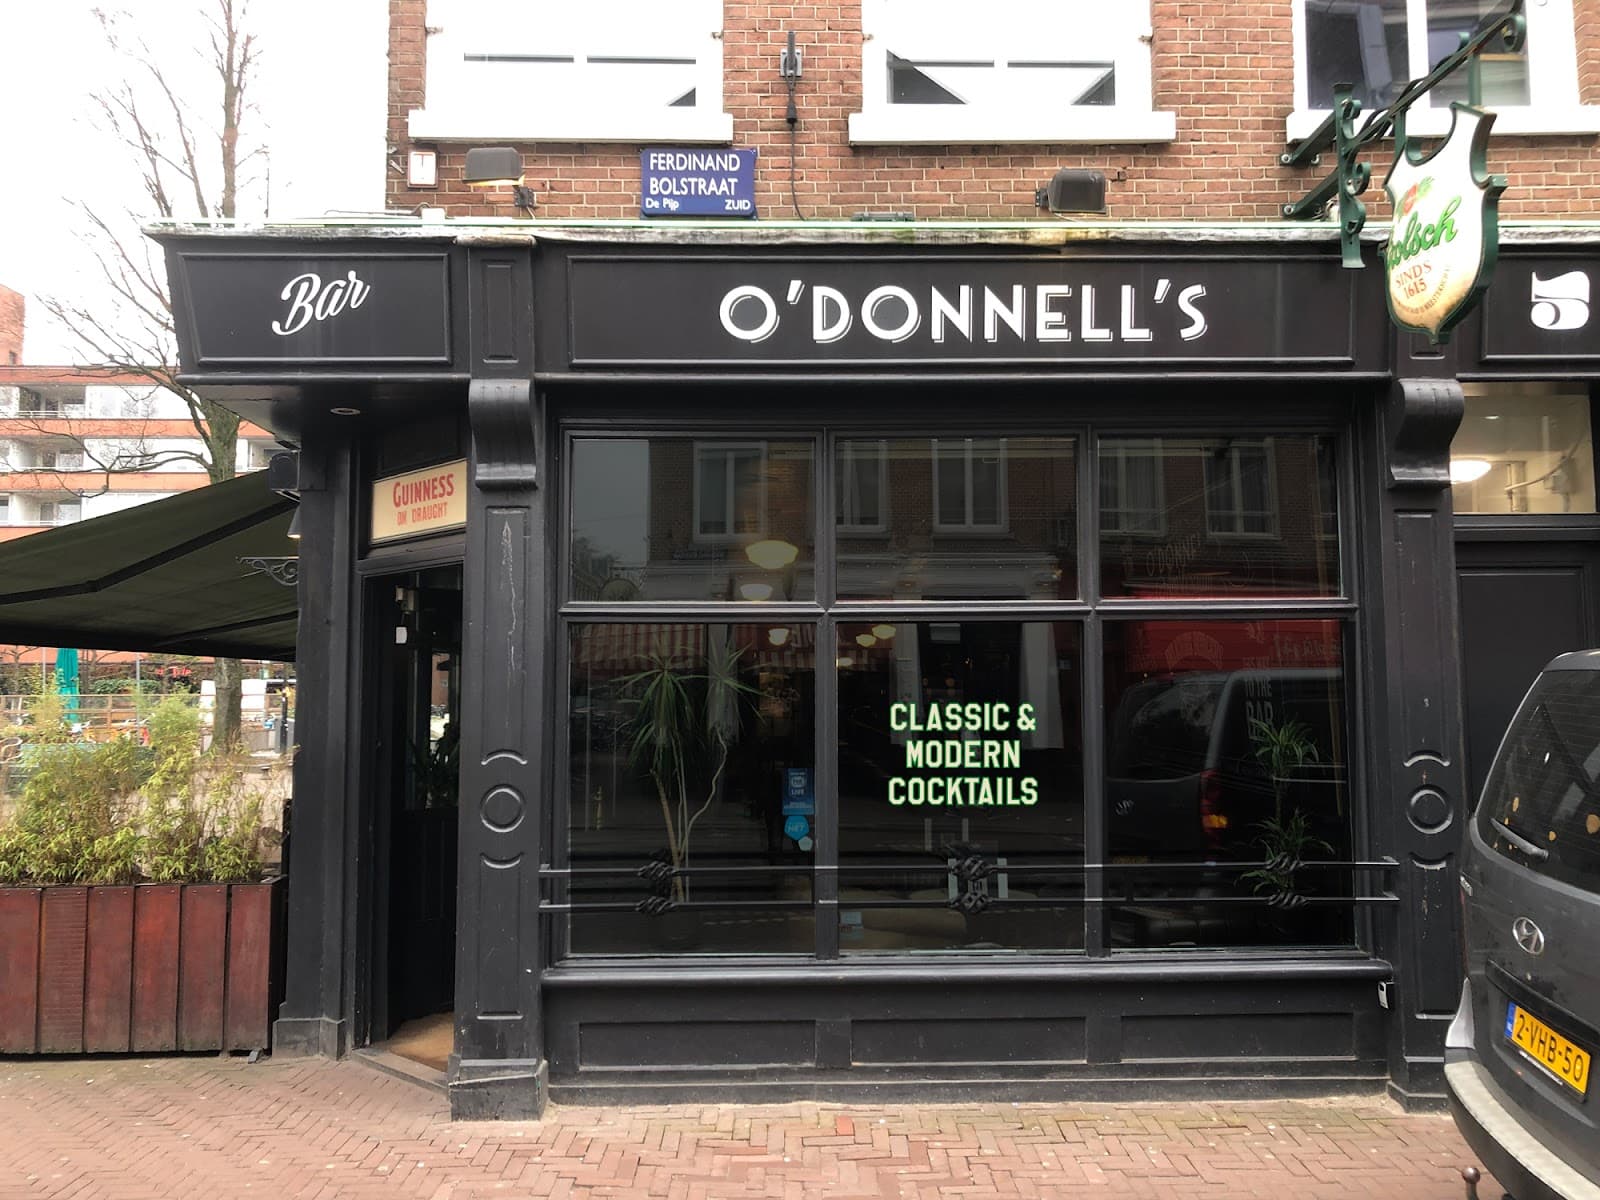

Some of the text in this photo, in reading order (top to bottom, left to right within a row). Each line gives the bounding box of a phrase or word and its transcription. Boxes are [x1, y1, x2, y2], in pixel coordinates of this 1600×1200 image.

[649, 153, 741, 171] FERDINAND
[649, 177, 739, 196] BOLSTRAAT
[645, 198, 660, 208] De
[724, 199, 751, 210] ZUID
[1403, 278, 1428, 299] 1615
[1531, 271, 1591, 330] 5
[271, 270, 371, 336] Bar
[719, 278, 1208, 343] O'DONNELL'S
[393, 473, 455, 508] GUINNESS
[411, 502, 448, 524] DRAUGHT
[889, 703, 1037, 731] CLASSIC &
[906, 739, 1021, 768] MODERN
[888, 777, 1039, 806] COCKTAILS
[1516, 1013, 1584, 1082] 2-VHB-50
